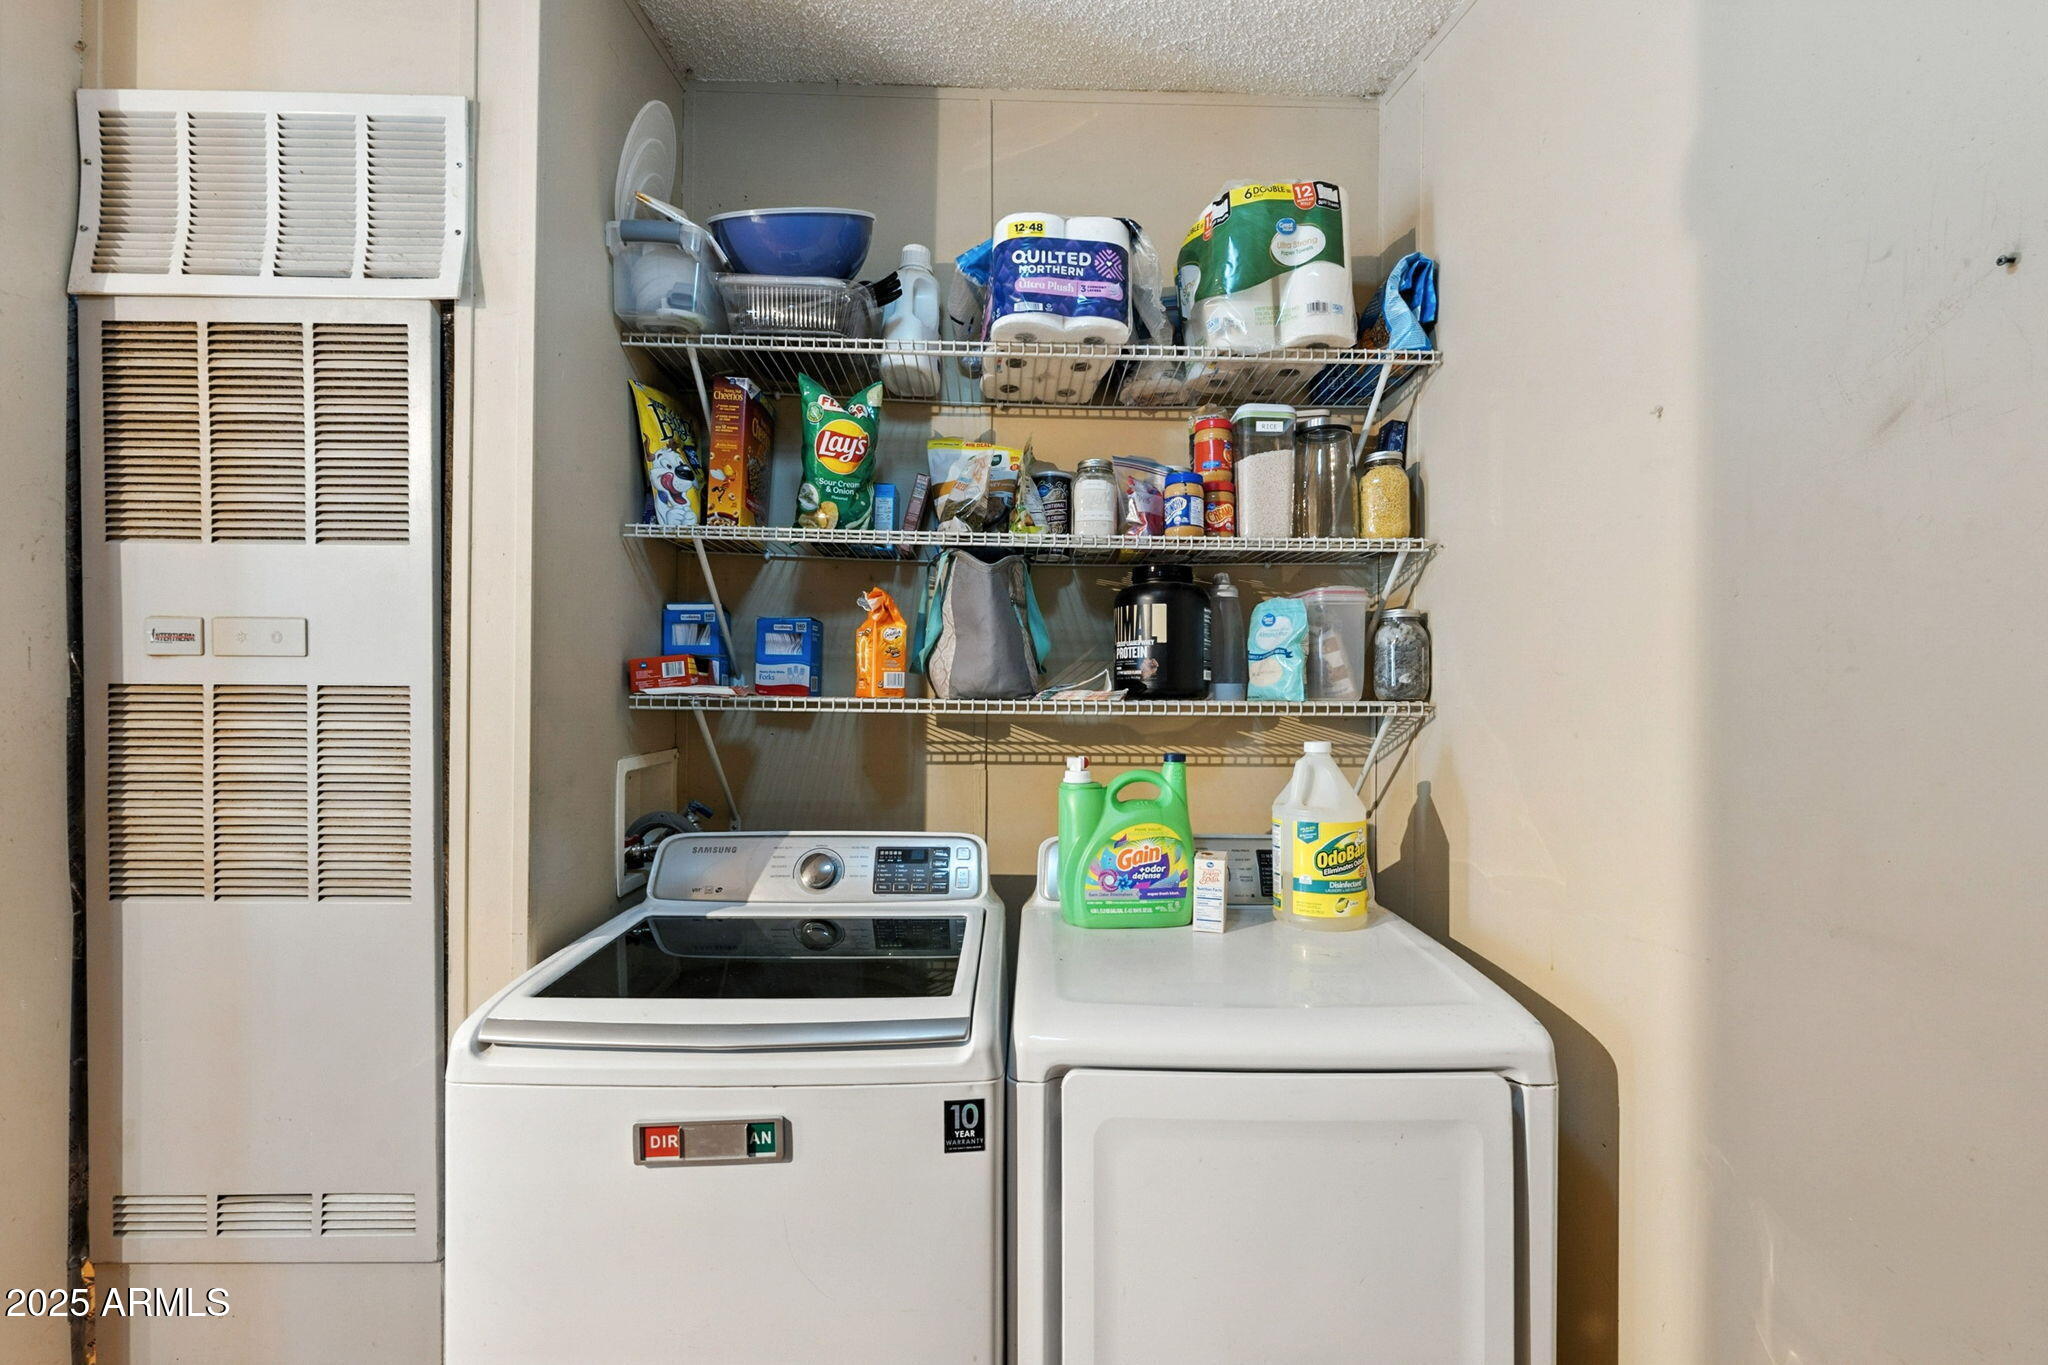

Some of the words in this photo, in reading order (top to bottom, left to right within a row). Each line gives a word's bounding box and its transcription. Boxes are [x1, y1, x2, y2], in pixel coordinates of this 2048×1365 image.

[1244, 188, 1253, 200] 6
[1253, 185, 1286, 195] DOUBLE
[1294, 185, 1312, 199] 12
[1011, 249, 1092, 267] QUILTED
[1018, 265, 1084, 277] NORTHERN
[1047, 280, 1075, 293] Plush
[1080, 284, 1087, 293] 3
[713, 390, 744, 401] Cheerios
[818, 431, 868, 463] Lay's
[818, 477, 836, 486] Sour
[837, 480, 860, 489] Cream
[833, 487, 855, 495] Onion
[1116, 646, 1148, 660] PROTEIN
[691, 846, 738, 854] SAMSUNG
[1316, 842, 1365, 869] OdoBan
[1117, 844, 1161, 871] Gain
[1139, 864, 1167, 874] +odor
[1323, 862, 1353, 876] Eliminates
[1132, 872, 1161, 880] defense
[1329, 880, 1362, 889] Disinfectant
[950, 1103, 979, 1129] 10
[954, 1130, 976, 1138] YEAR
[650, 1134, 679, 1148] DIR
[945, 1138, 984, 1146] WARRANTY
